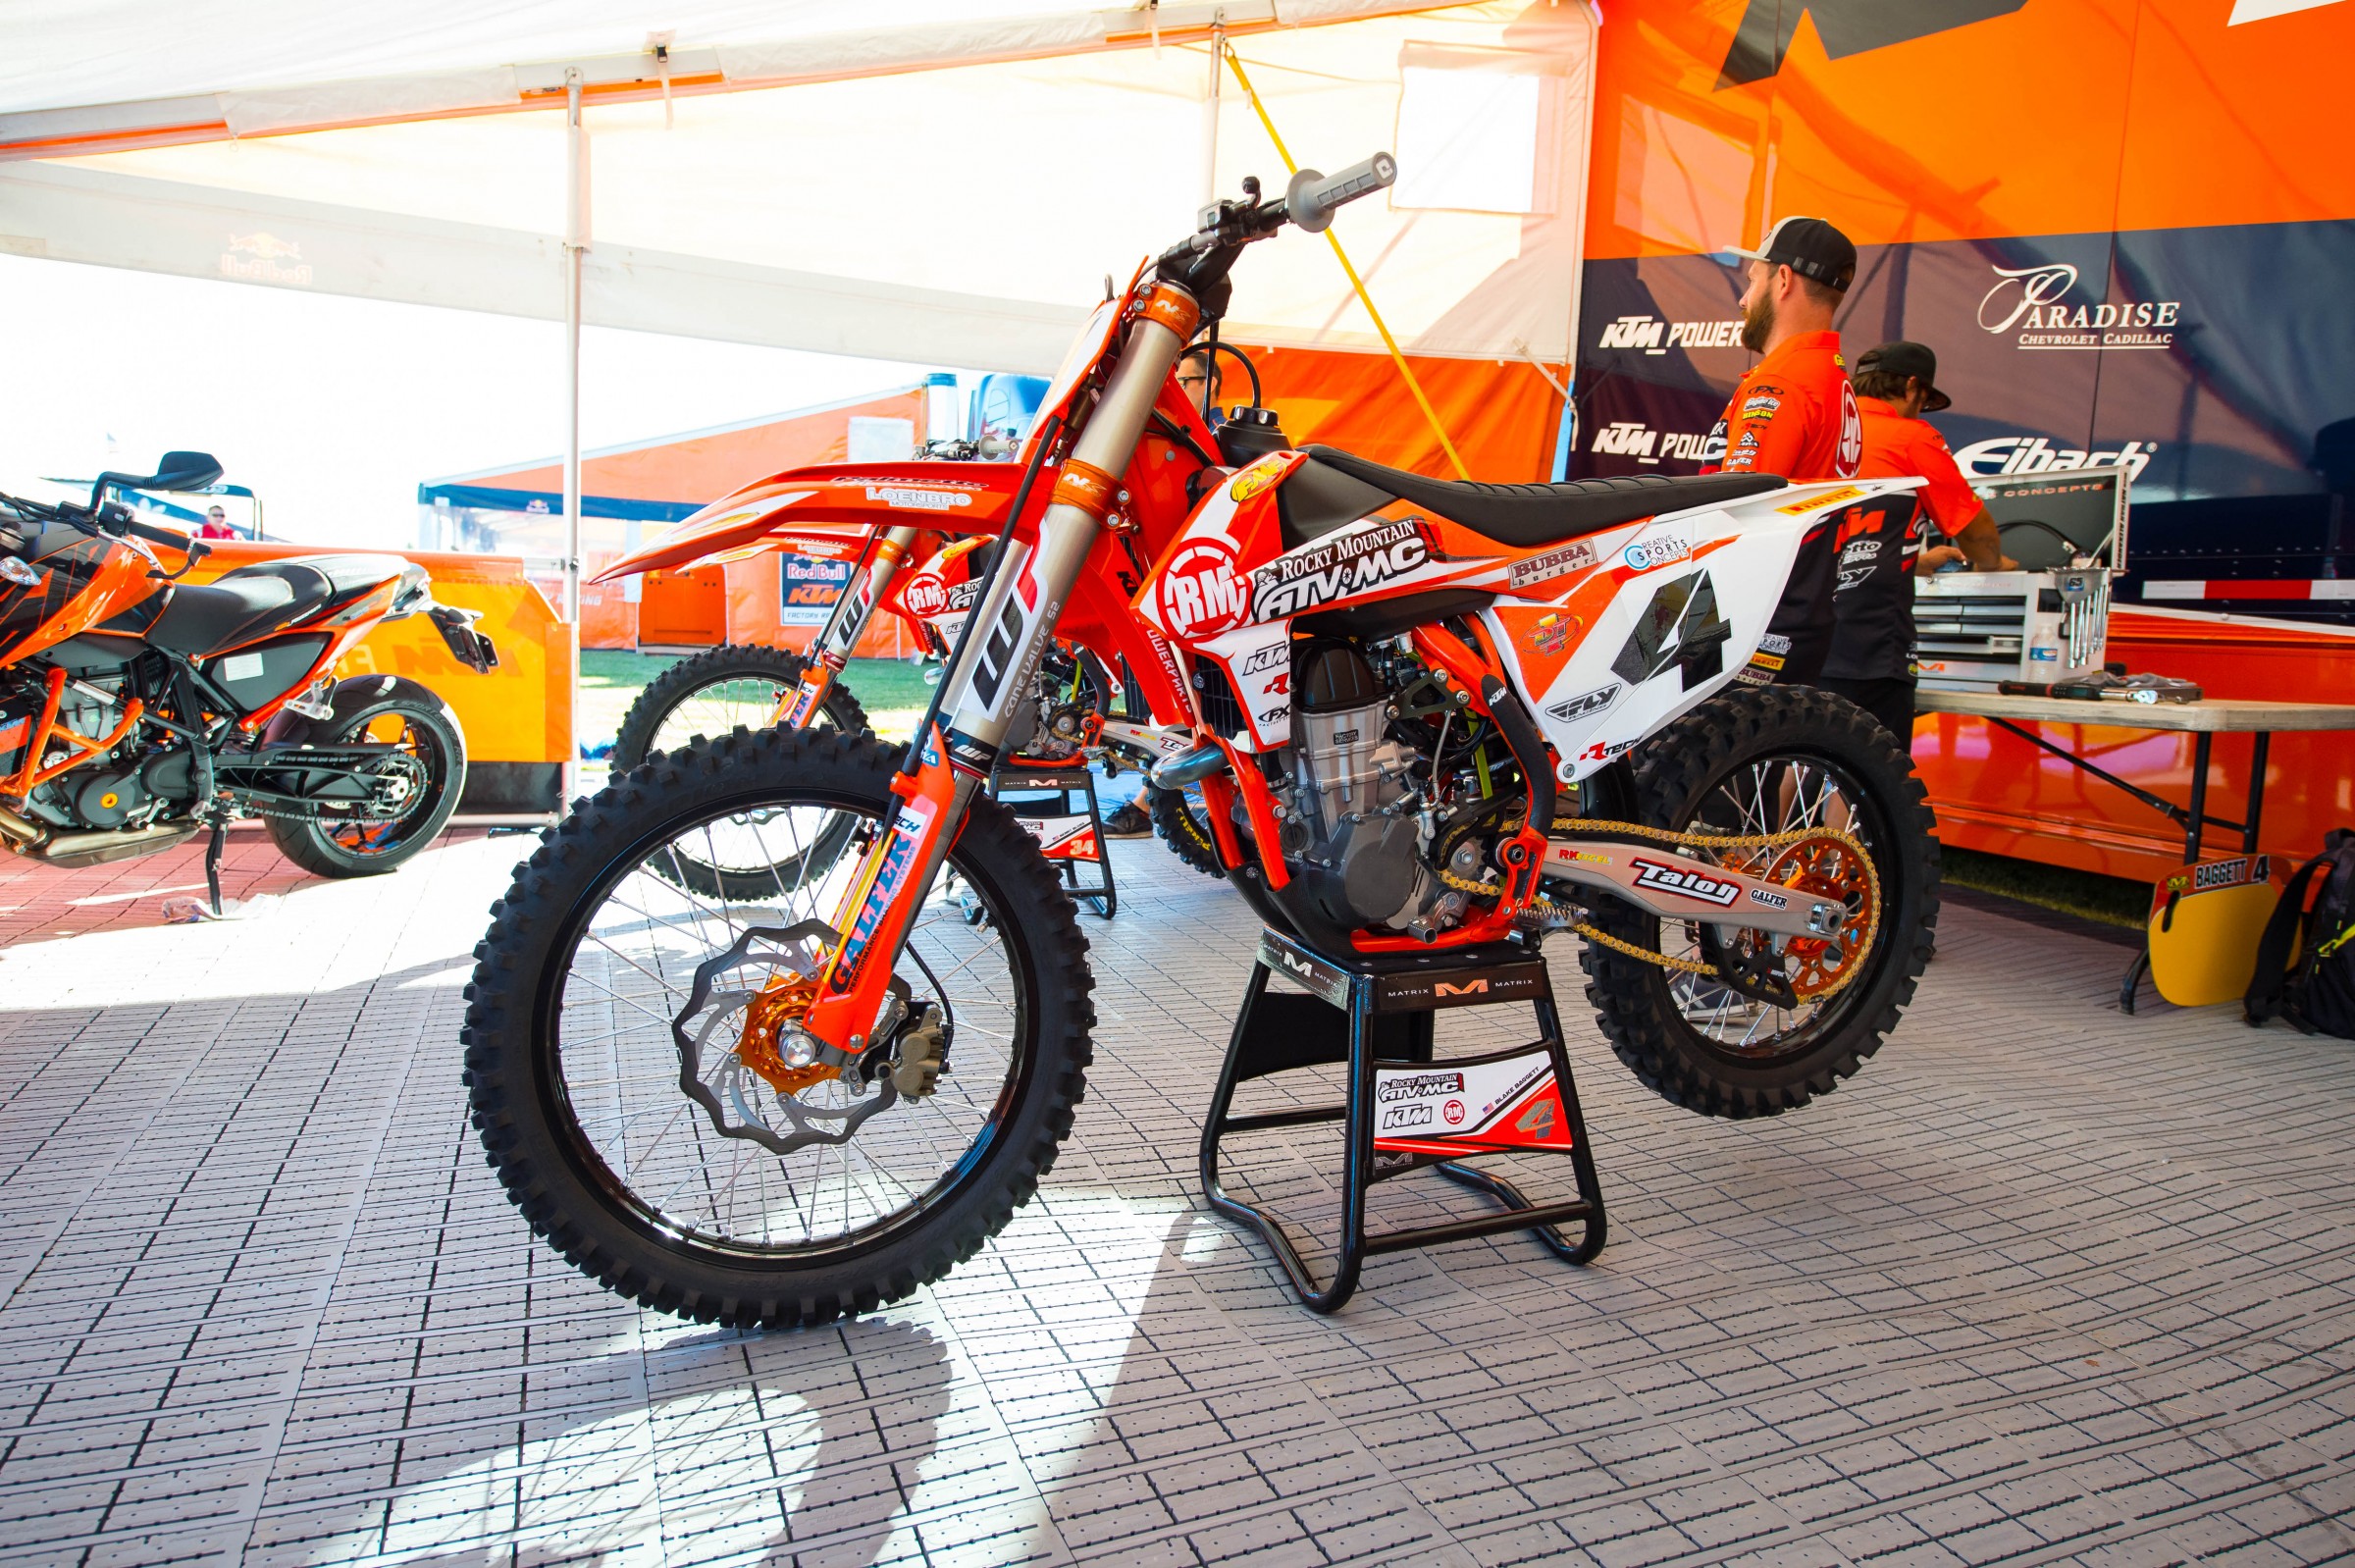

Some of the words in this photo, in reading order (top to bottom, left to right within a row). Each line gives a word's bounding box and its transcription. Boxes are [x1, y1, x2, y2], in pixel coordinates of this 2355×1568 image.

[1977, 263, 2180, 335] PARADISE
[1599, 316, 1665, 352] KTM
[2018, 334, 2097, 345] CHEVROLET
[2103, 333, 2173, 344] CADILLAC
[1592, 422, 1659, 463] KTM
[1953, 438, 2150, 482] Eibach
[866, 487, 972, 506] LOENBRO
[1234, 459, 1287, 503] FMF
[2004, 483, 2104, 497] CONCEPTS
[1788, 490, 1856, 512] PIRELLI
[1281, 549, 1332, 583] ROCKY
[1335, 519, 1416, 563] MOUNTAIN
[1514, 544, 1591, 579] BUBBA
[1638, 539, 1688, 561] SPORTS
[787, 563, 816, 580] Red
[817, 563, 846, 580] Bull
[1517, 557, 1594, 587] burger
[2068, 577, 2083, 587] 65
[1610, 567, 1732, 693] 4
[1005, 672, 1027, 719] CONE
[1021, 625, 1050, 674] VALVE
[1047, 601, 1060, 620] 52
[1136, 616, 1192, 713] OWERPARTS
[1489, 686, 1507, 706] KTM
[1547, 685, 1620, 718] FLY
[1069, 839, 1094, 856] 34
[1634, 860, 1743, 906] Talon
[2194, 859, 2247, 889] BAGGETT
[2252, 855, 2270, 883] 4
[831, 833, 913, 995] GALFER
[1752, 889, 1787, 909] GALFER
[849, 925, 881, 994] PERFORMANCE
[896, 846, 916, 887] SYSTEMS
[1387, 988, 1430, 997] MATRIX
[1391, 1078, 1416, 1089] ROCKY
[1417, 1073, 1458, 1085] MOUNTAIN
[1494, 1085, 1516, 1105] BLAKE
[1514, 1066, 1540, 1088] BAGGETT
[1383, 1103, 1433, 1129] KTM
[1515, 1098, 1555, 1139] 4
